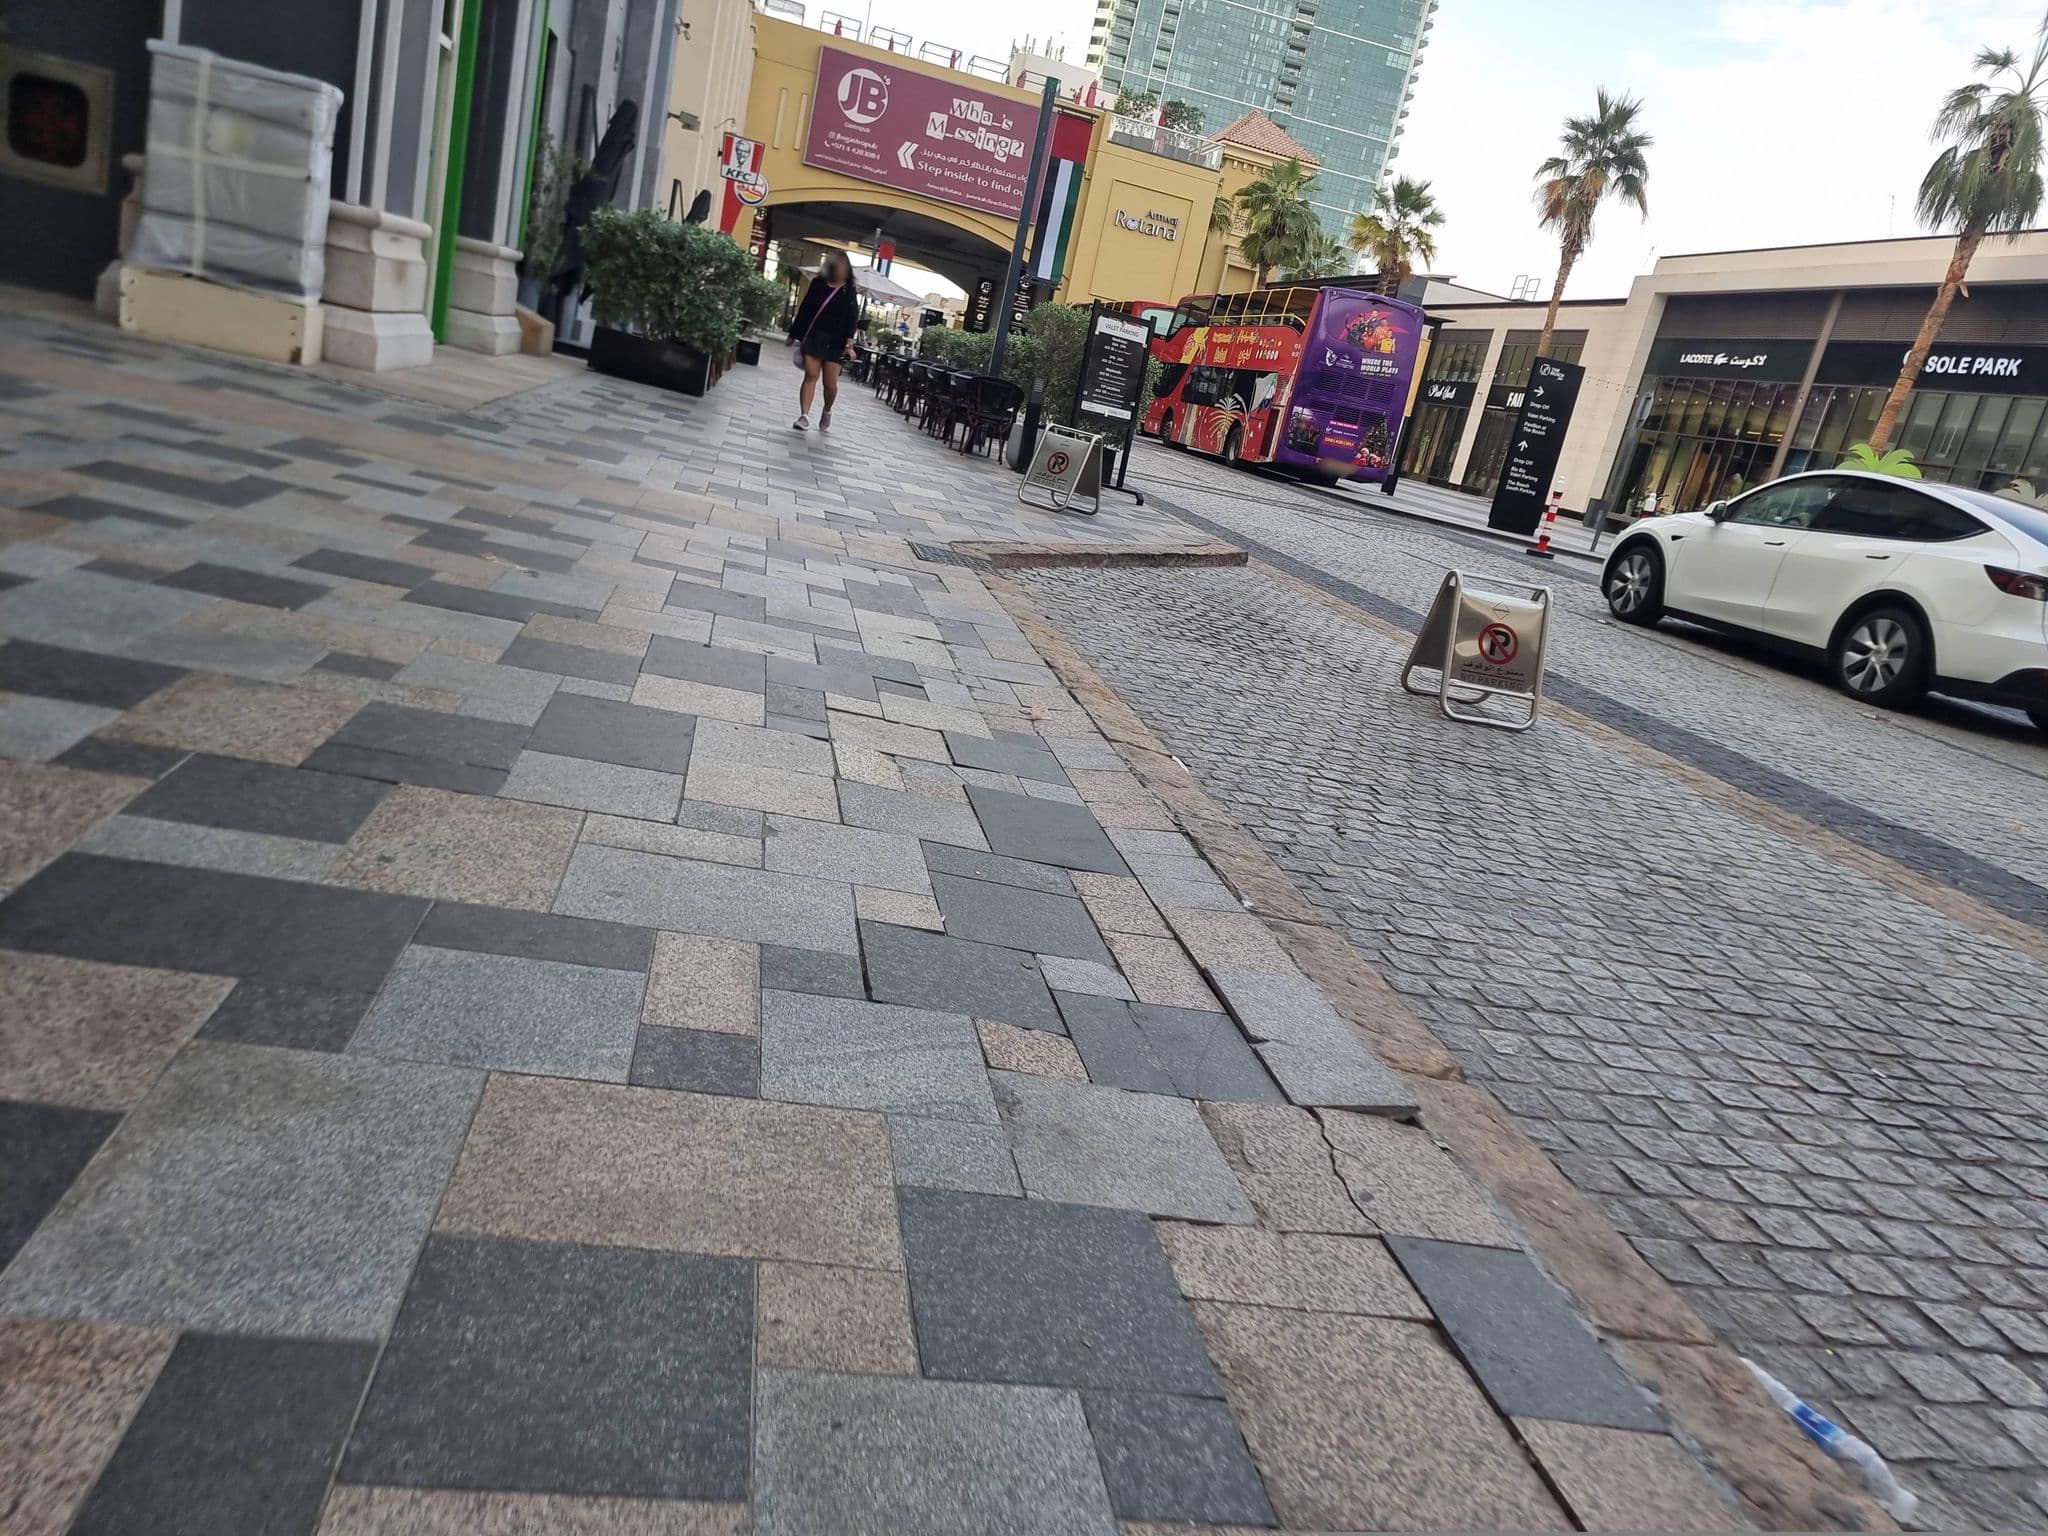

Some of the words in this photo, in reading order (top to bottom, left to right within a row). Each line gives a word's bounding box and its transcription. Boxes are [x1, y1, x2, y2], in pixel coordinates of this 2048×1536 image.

[726, 167, 751, 182] KFC
[917, 161, 942, 177] Step
[943, 168, 975, 184] inside
[977, 177, 989, 187] to
[991, 180, 1011, 194] find
[1114, 209, 1177, 242] Rotana
[1146, 210, 1179, 228] Amwaj
[1105, 323, 1119, 332] VALET
[1119, 326, 1140, 338] PARKING
[1361, 357, 1380, 366] WHERE
[1680, 353, 1714, 365] LACOSTE
[1729, 354, 1768, 369] لاكوست
[1925, 355, 1972, 375] SOLE
[1972, 357, 2023, 377] PARK
[1360, 364, 1380, 373] WORLD
[1381, 366, 1399, 375] PLAYS
[1539, 415, 1556, 424] Parking
[1513, 457, 1525, 465] Drop
[1510, 471, 1521, 479] Valet
[1521, 474, 1538, 483] Parking
[1519, 488, 1536, 497] Parking
[1489, 629, 1511, 656] P
[1460, 672, 1475, 681] NO
[1478, 675, 1525, 690] PARKING
